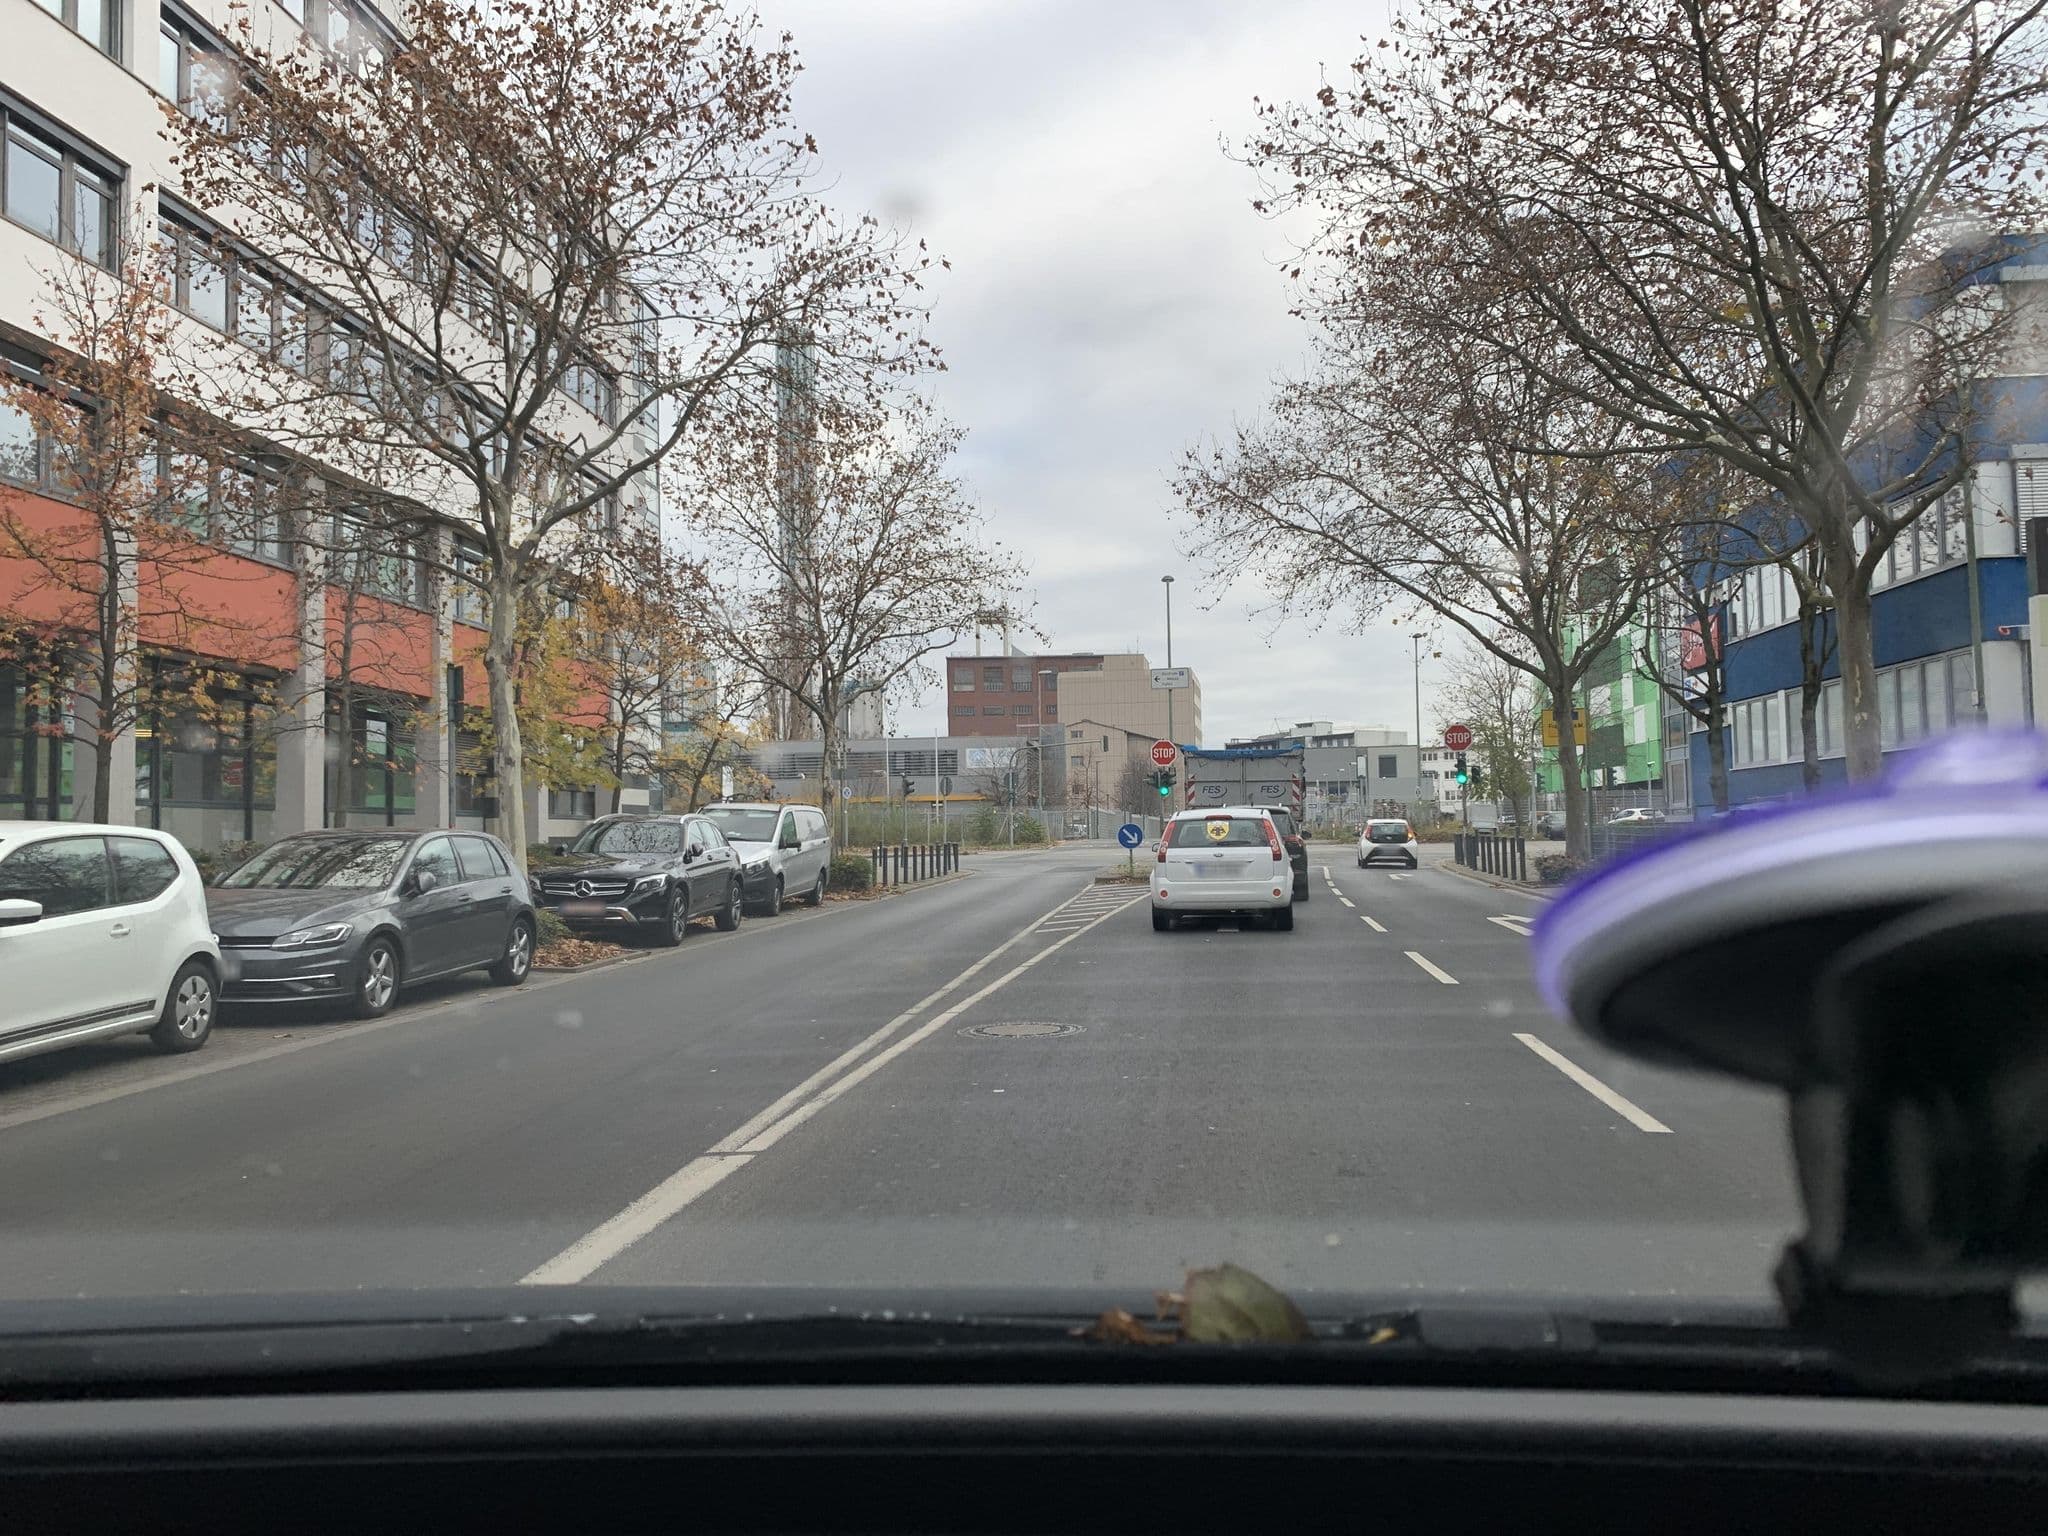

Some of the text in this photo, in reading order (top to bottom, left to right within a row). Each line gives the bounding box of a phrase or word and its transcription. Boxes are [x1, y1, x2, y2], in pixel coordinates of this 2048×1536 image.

[1446, 732, 1470, 744] STOP
[1153, 747, 1175, 759] STOP
[1202, 785, 1222, 794] FES
[1260, 785, 1281, 794] FES
